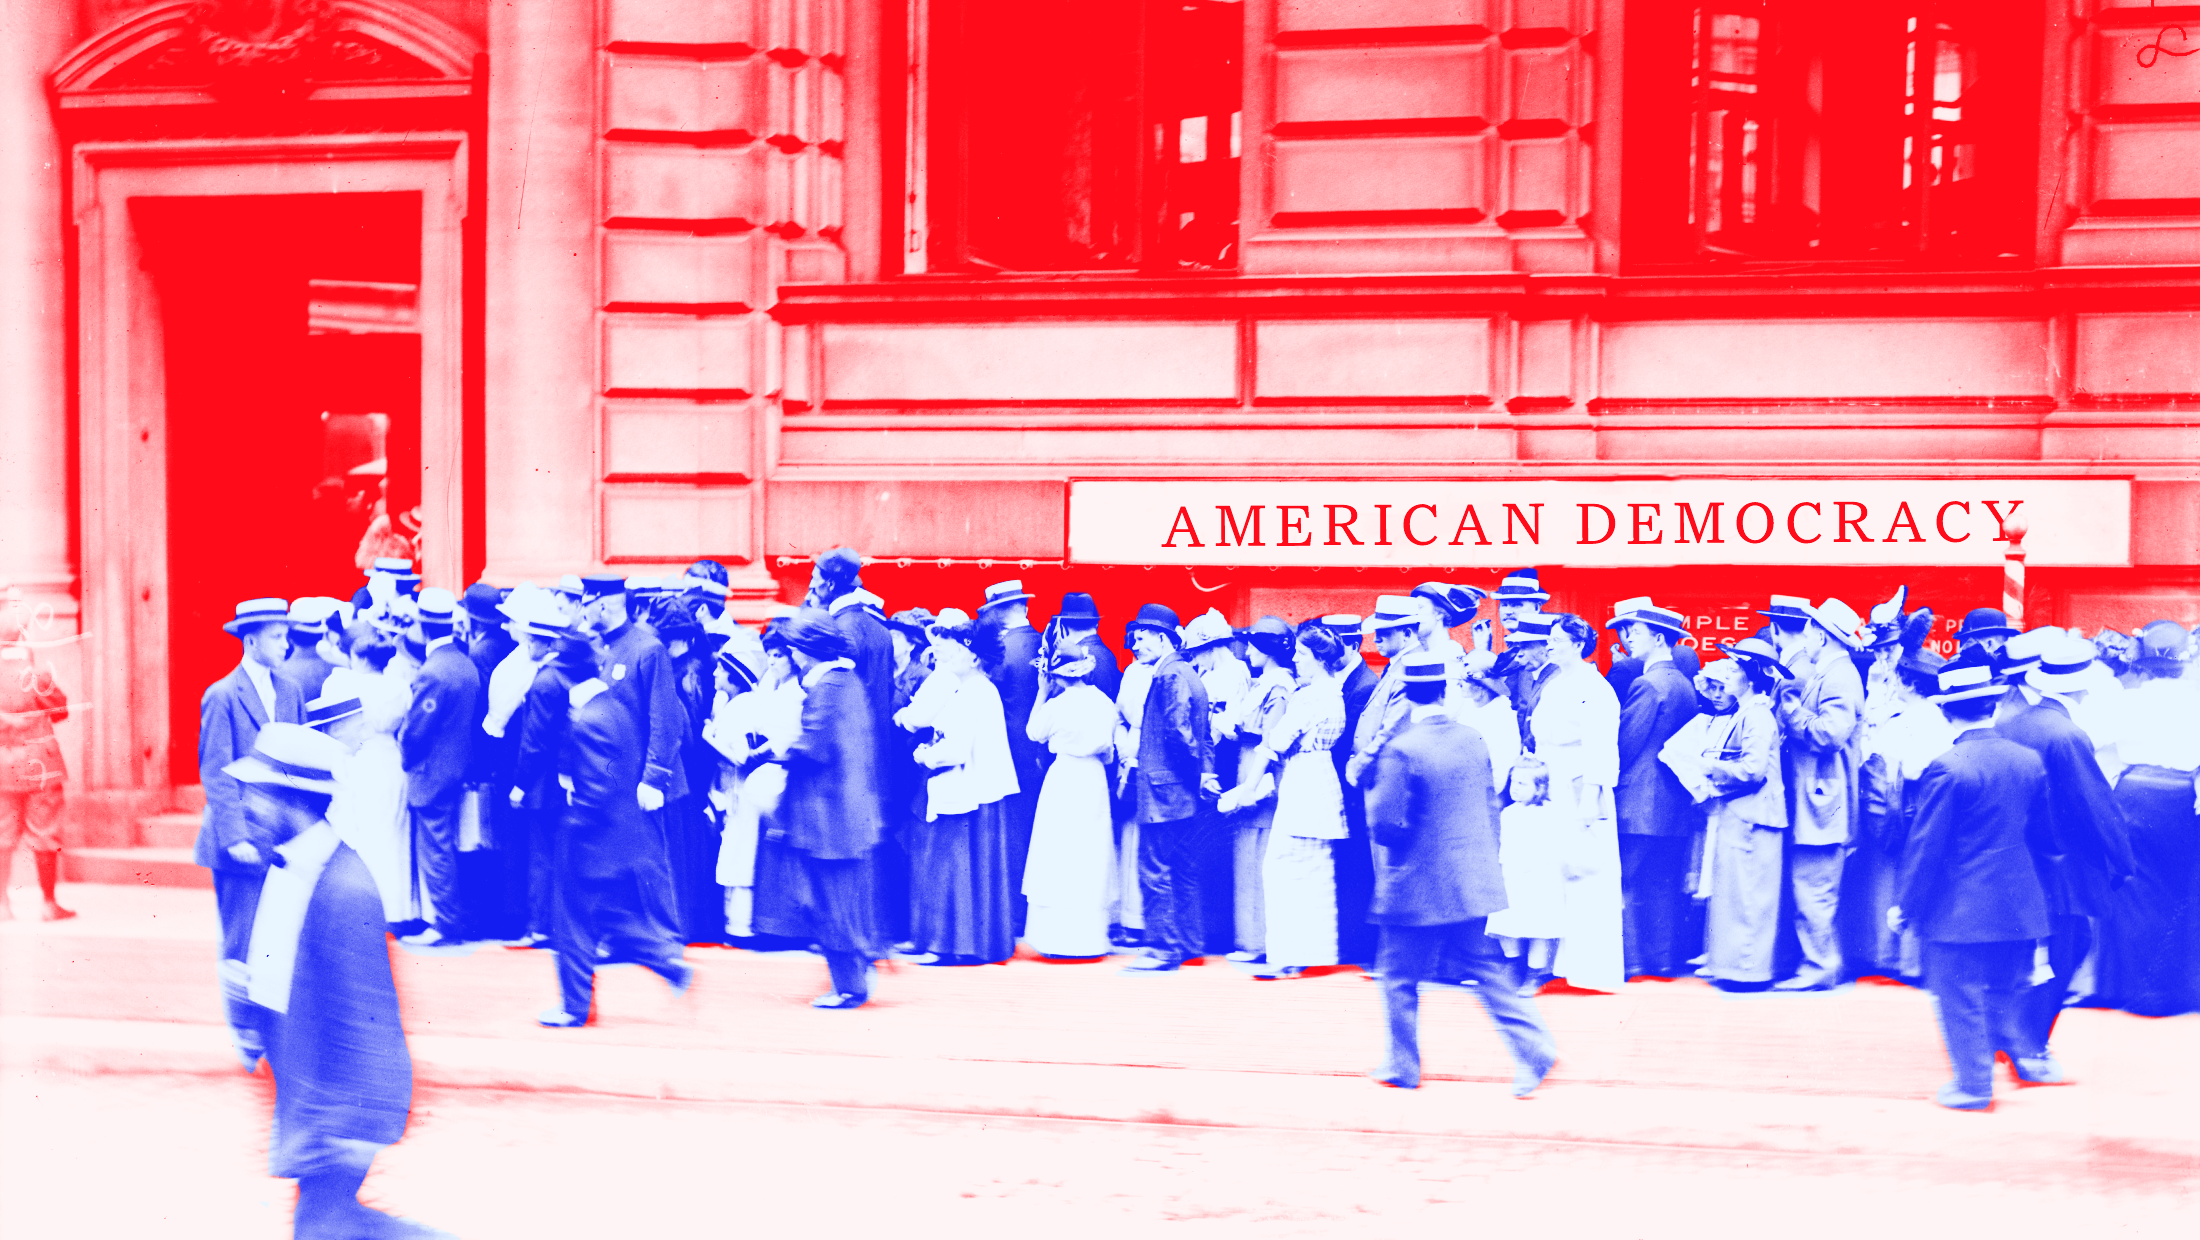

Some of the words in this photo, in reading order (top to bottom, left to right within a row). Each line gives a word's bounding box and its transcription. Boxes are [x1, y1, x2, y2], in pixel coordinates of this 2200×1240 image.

[1161, 503, 1545, 548] AMERICAN
[1576, 499, 2025, 545] DEMOCRACY
[1682, 615, 1749, 631] MPLE
[1680, 637, 1737, 652] OES
